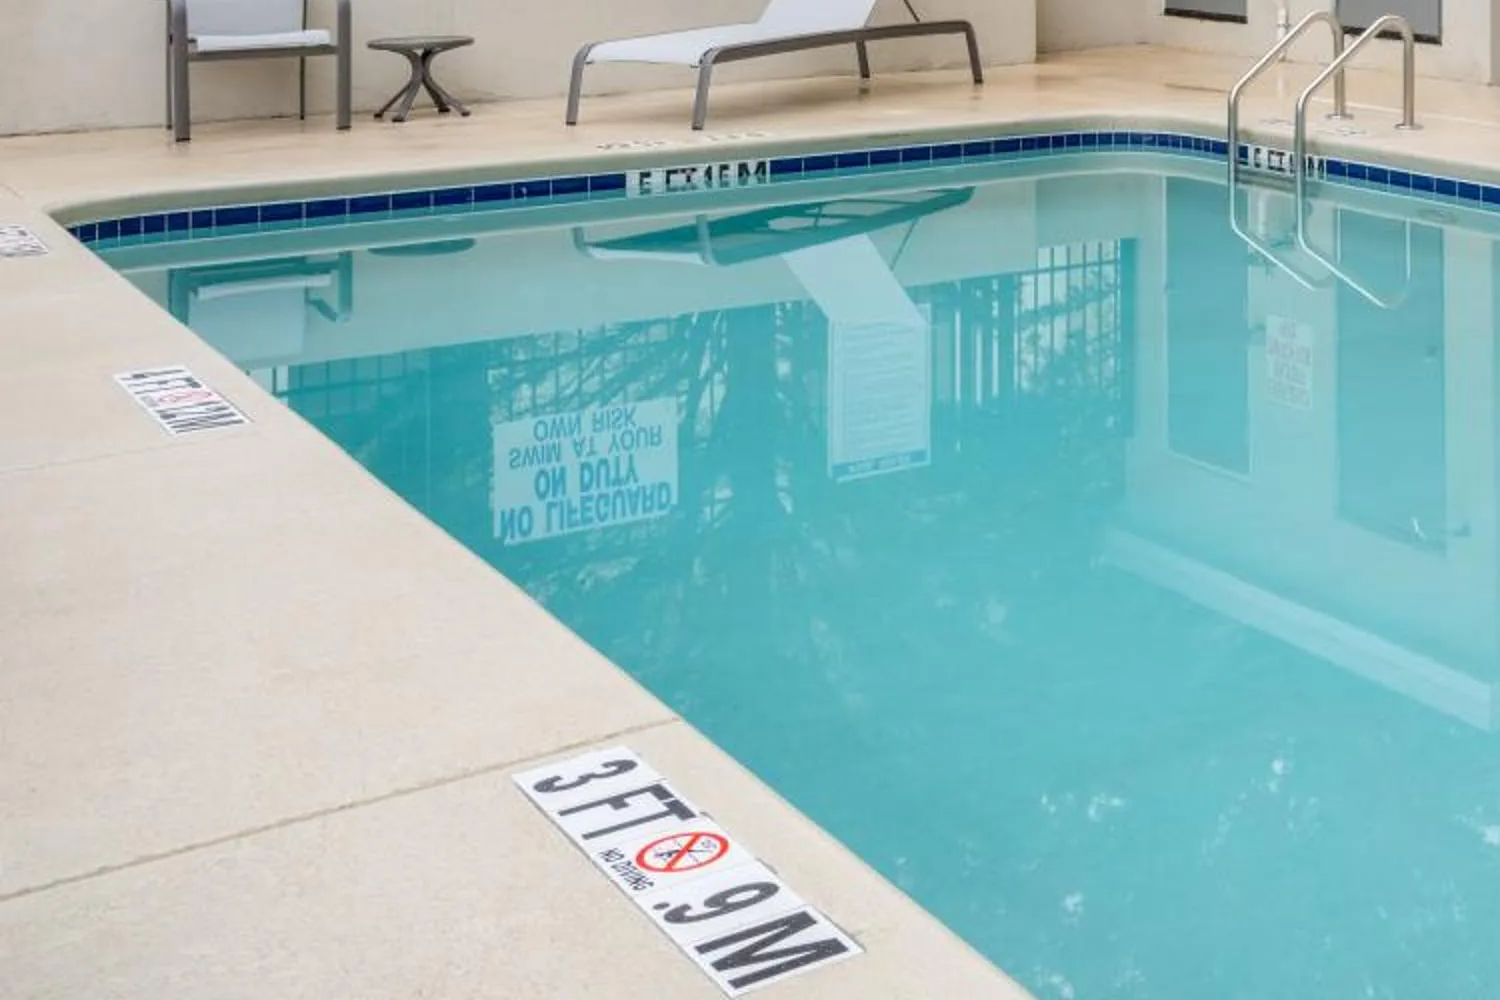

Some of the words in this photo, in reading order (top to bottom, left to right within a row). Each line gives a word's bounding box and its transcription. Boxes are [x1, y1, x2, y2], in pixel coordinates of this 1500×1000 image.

[532, 758, 638, 793] 3
[558, 783, 697, 841] FT
[610, 860, 655, 890] DIVING
